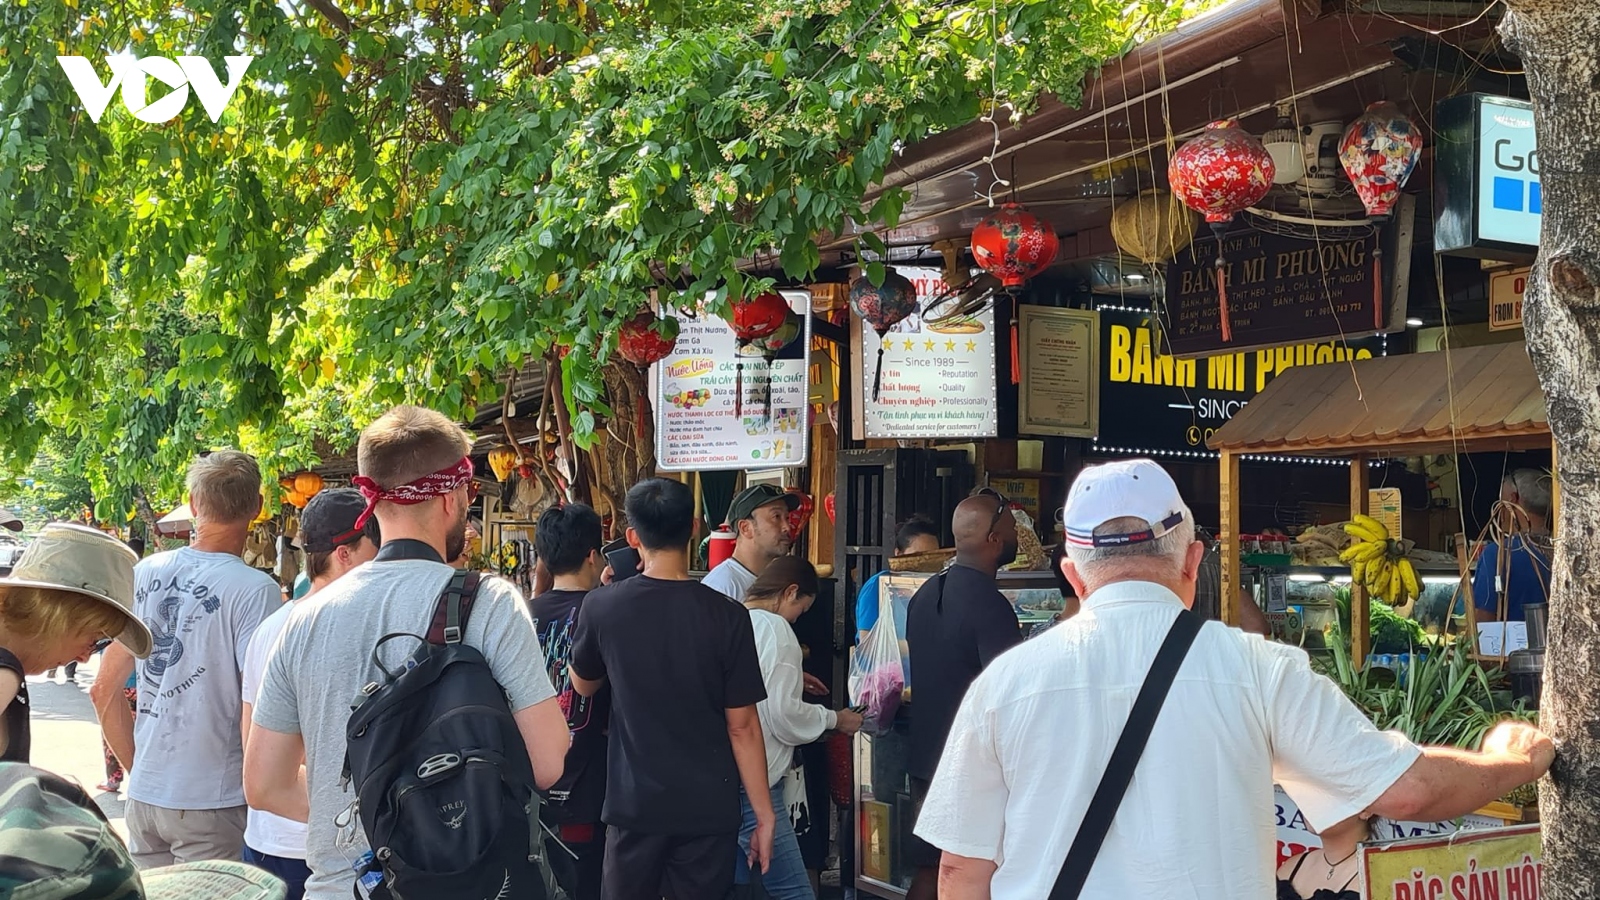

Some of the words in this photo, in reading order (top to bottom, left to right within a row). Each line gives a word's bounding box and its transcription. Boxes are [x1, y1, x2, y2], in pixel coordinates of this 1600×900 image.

[1181, 261, 1233, 295] BÁNH
[1241, 250, 1267, 285] MÌ
[1275, 239, 1365, 279] PHƯỢNG
[1226, 304, 1239, 314] ÁC
[1243, 302, 1260, 313] LOẠI
[1494, 303, 1513, 322] FROM
[690, 327, 703, 335] Thịt
[905, 357, 930, 367] Since
[933, 358, 954, 367] 1989
[942, 369, 978, 379] Reputation
[700, 376, 716, 385] TRÁI
[753, 375, 783, 385] NGUÊN
[880, 383, 896, 392] hất
[898, 382, 921, 393] lượng
[942, 383, 966, 393] Quality
[943, 397, 988, 406] Professionally
[1198, 398, 1248, 420] SINC
[936, 423, 945, 432] for
[1007, 482, 1025, 493] WIFI
[160, 665, 206, 700] NOTHING
[436, 799, 465, 815] PREY
